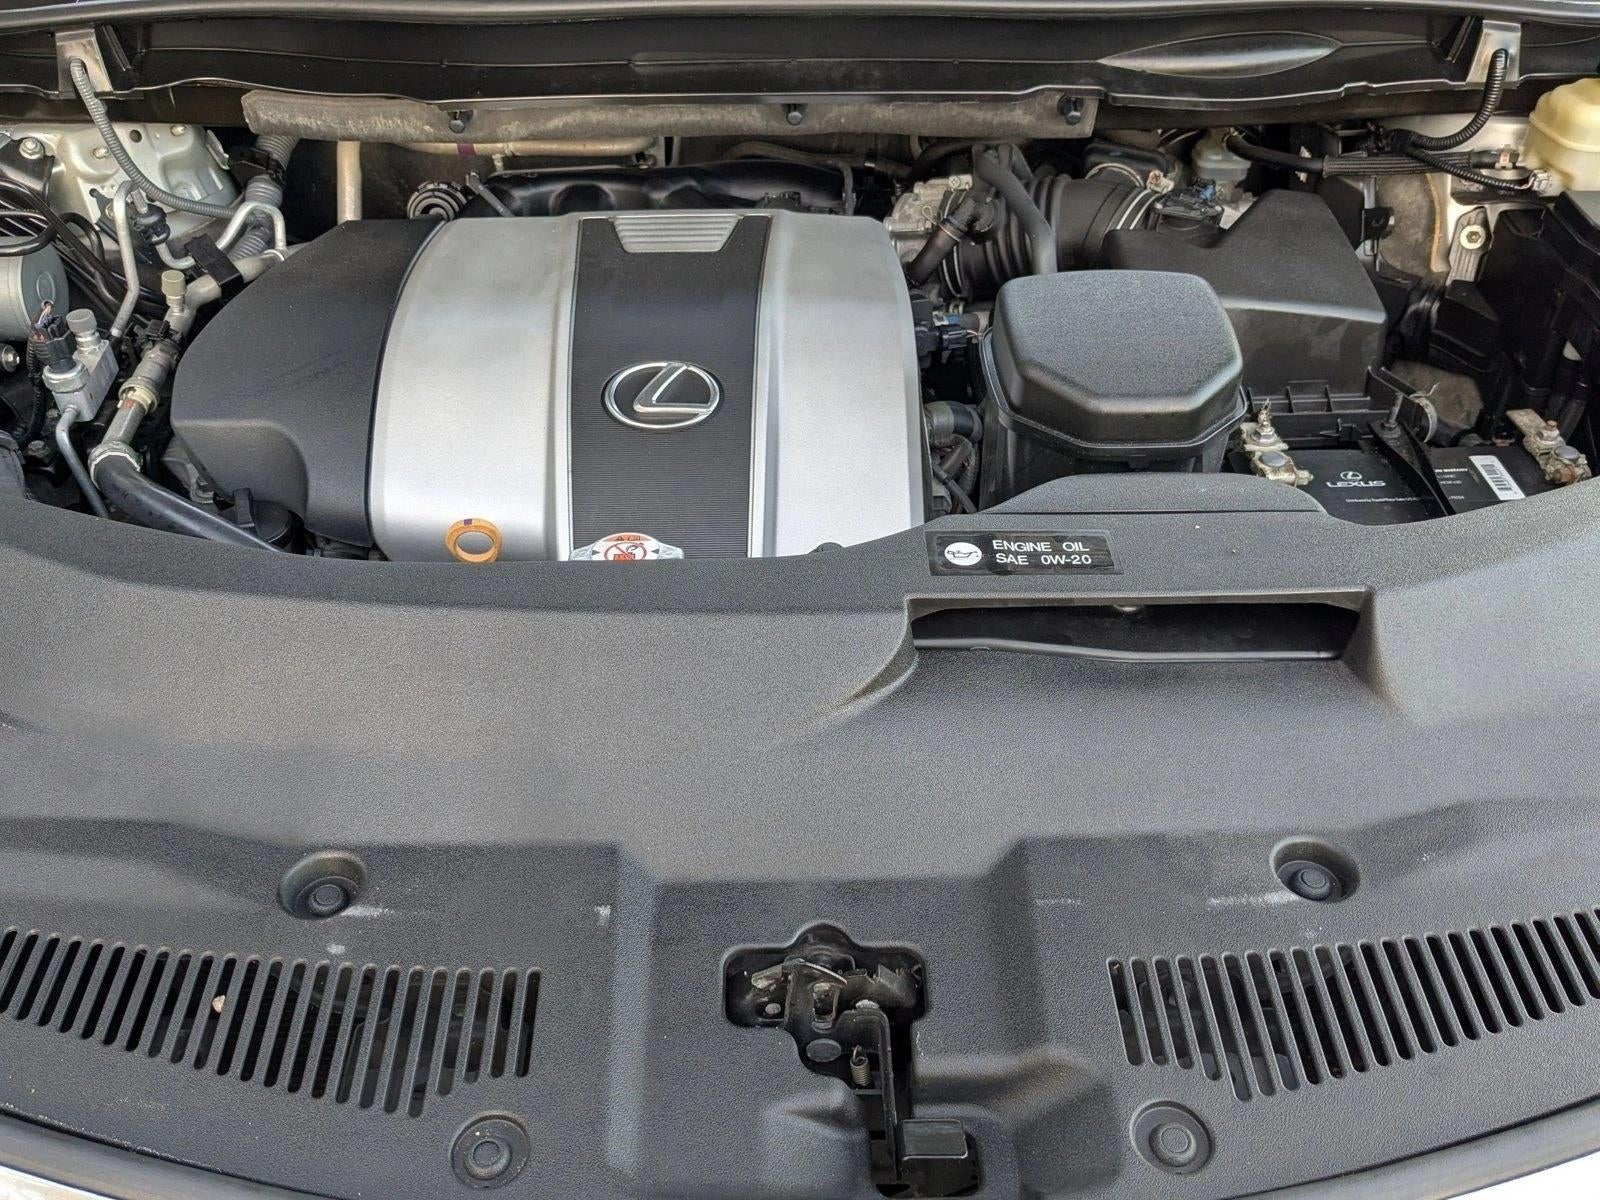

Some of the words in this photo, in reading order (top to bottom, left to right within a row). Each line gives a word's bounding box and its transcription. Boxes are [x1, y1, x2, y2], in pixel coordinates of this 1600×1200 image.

[1325, 480, 1386, 488] LEXUS
[992, 540, 1052, 552] ENGINE
[1062, 541, 1090, 552] OIL
[996, 553, 1029, 565] SAE
[1040, 554, 1092, 565] 0W-20
